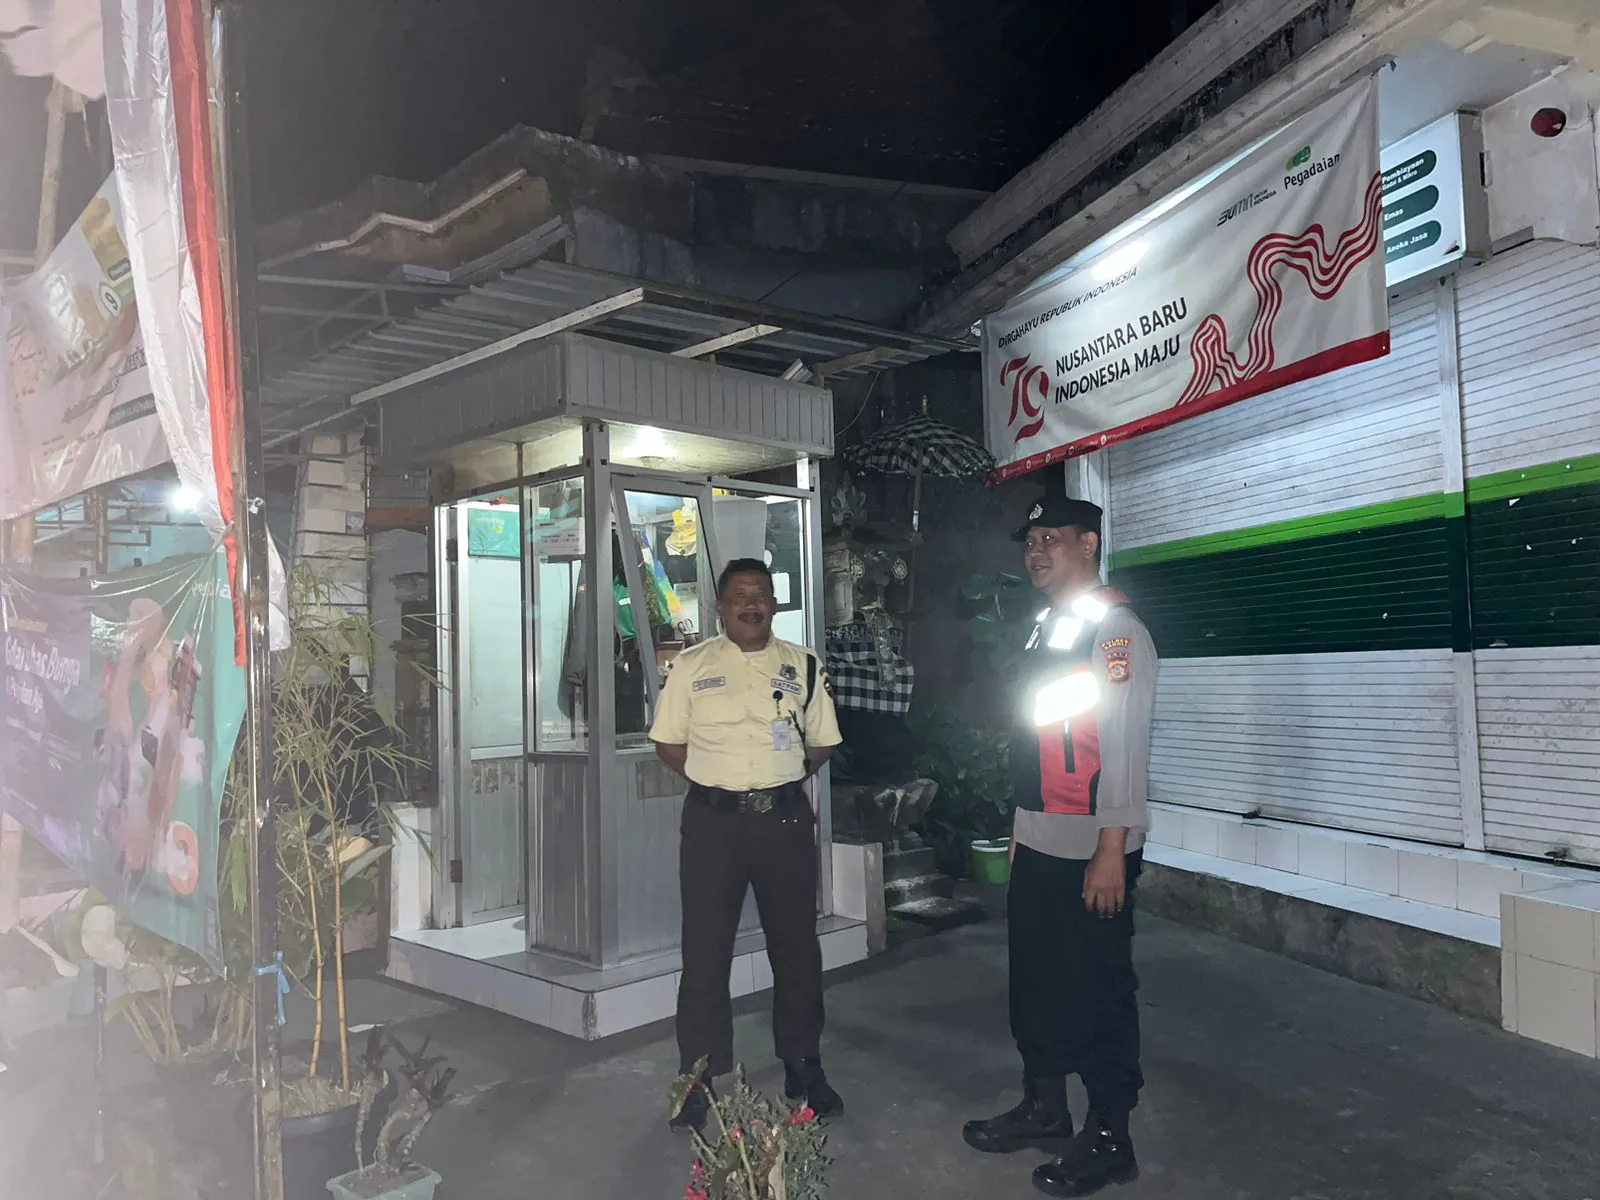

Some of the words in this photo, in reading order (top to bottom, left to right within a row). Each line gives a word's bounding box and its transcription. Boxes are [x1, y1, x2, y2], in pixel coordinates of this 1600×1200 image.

[1283, 153, 1341, 190] Pegadaian
[1384, 208, 1404, 222] Emas
[1386, 240, 1409, 255] Aneka
[1410, 232, 1428, 245] Jasa
[998, 316, 1040, 349] DIRGAHAYU
[1040, 294, 1083, 326] REPUBLIK
[1083, 267, 1137, 304] INDONESIA
[1056, 322, 1138, 377] NUSANTARA
[1139, 297, 1187, 337] BARU
[1055, 358, 1130, 404] INDONESIA
[1134, 334, 1181, 373] MAJU
[1000, 351, 1050, 444] 79
[773, 680, 800, 693] SATPAM
